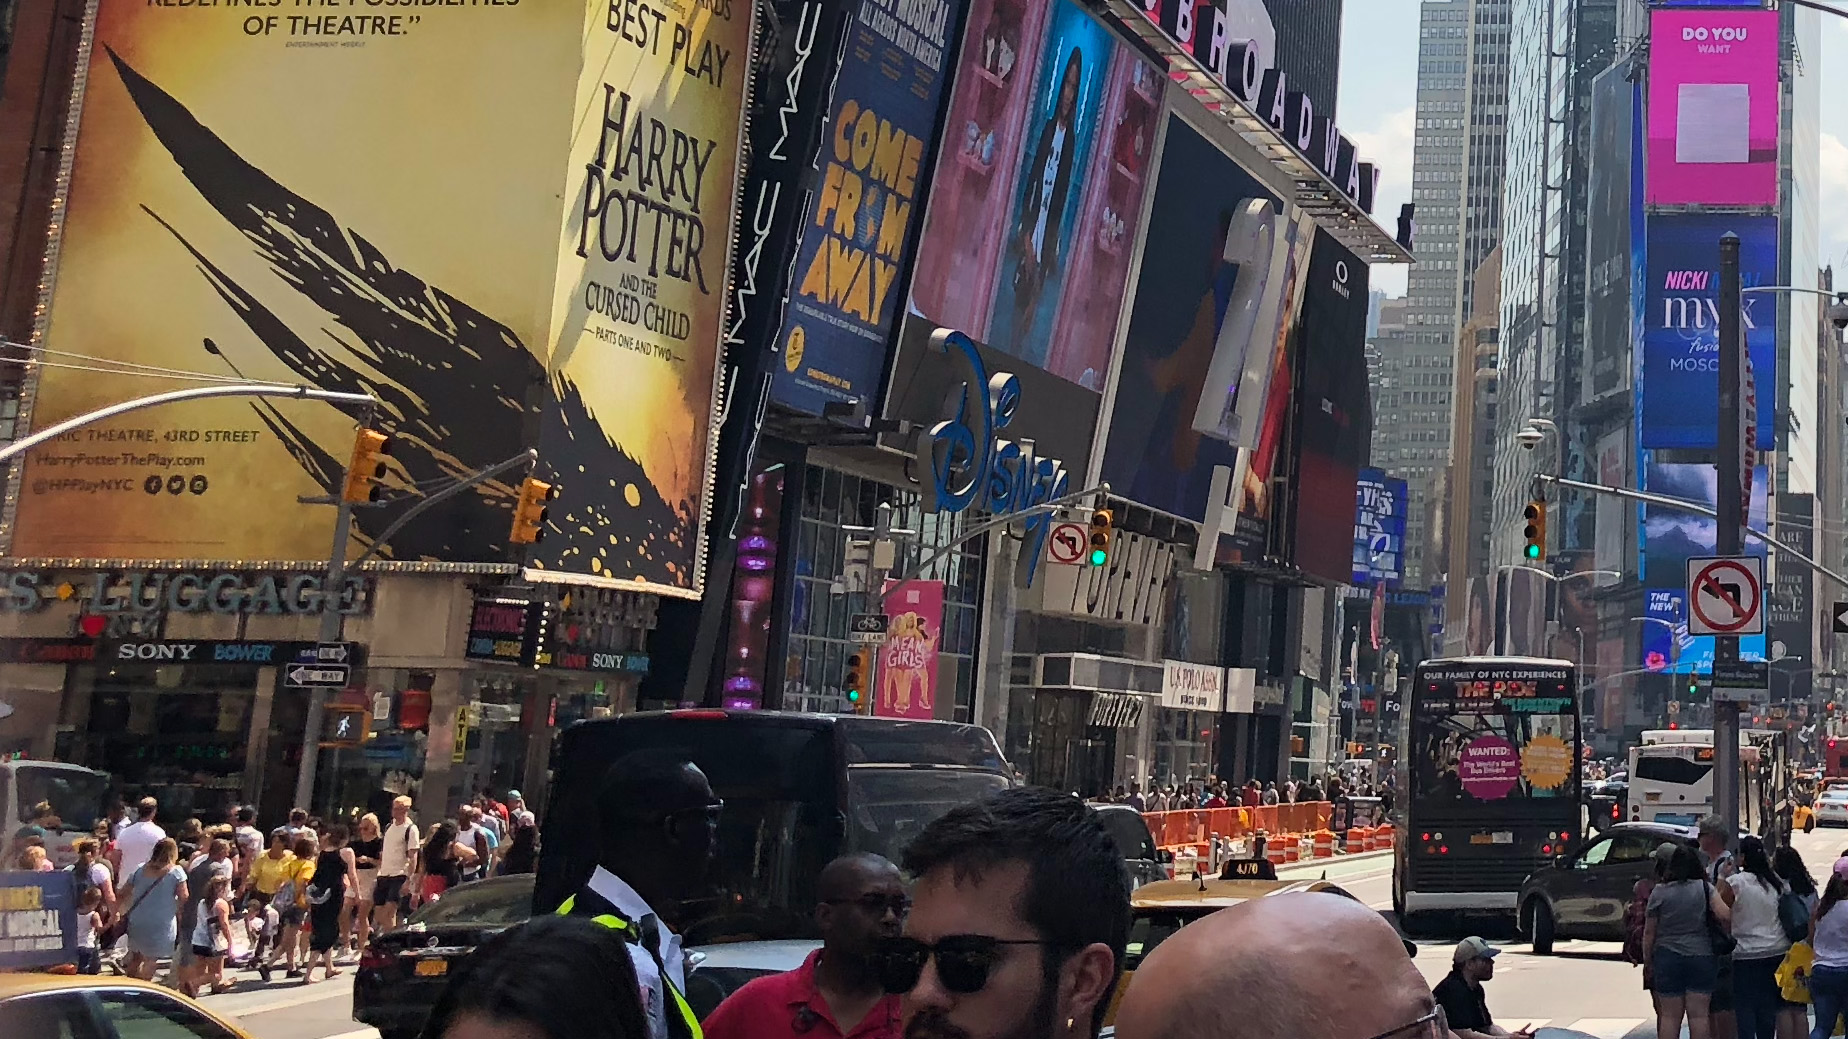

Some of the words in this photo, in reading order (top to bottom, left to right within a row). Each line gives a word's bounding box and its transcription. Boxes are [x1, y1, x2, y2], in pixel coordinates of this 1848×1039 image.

[243, 15, 278, 36] OF
[1682, 27, 1707, 42] DO
[1711, 27, 1748, 42] YOU
[858, 0, 873, 28] ALL
[870, 8, 899, 44] ACROSS
[895, 24, 918, 57] NORTH
[914, 36, 943, 74] AMERICA
[669, 22, 730, 88] PLAY
[1697, 44, 1731, 55] WANT
[594, 83, 718, 214] HARRY
[834, 98, 924, 200] COME
[815, 161, 911, 264] FROM
[575, 163, 710, 296] POTTER
[619, 272, 640, 294] AND
[641, 277, 657, 299] THE
[799, 233, 898, 327] AWAY
[1664, 270, 1709, 290] NICKI
[585, 280, 641, 325] CURSED
[643, 300, 691, 342] CHILD
[595, 326, 617, 345] PARTS
[618, 331, 634, 350] ONE
[635, 337, 652, 356] AND
[653, 344, 672, 362] TWO
[87, 429, 158, 444] THEATRE,
[163, 431, 200, 442] 43RD
[204, 430, 261, 443] STREET
[930, 330, 1070, 589] Disney
[97, 572, 367, 615] LUGGAGE
[1651, 592, 1671, 602] THE
[1650, 602, 1674, 611] NEW
[118, 643, 197, 660] SONY
[214, 644, 276, 661] BOWER
[889, 636, 926, 655] MEAN
[592, 652, 624, 669] SONY
[887, 651, 926, 669] GIRLS
[1423, 671, 1443, 679] OUR
[1445, 671, 1476, 679] FAMILY
[1477, 670, 1490, 679] OF
[1491, 670, 1510, 679] NYC
[1512, 670, 1567, 679] EXPERIENCES
[1468, 746, 1511, 757] WANTED:
